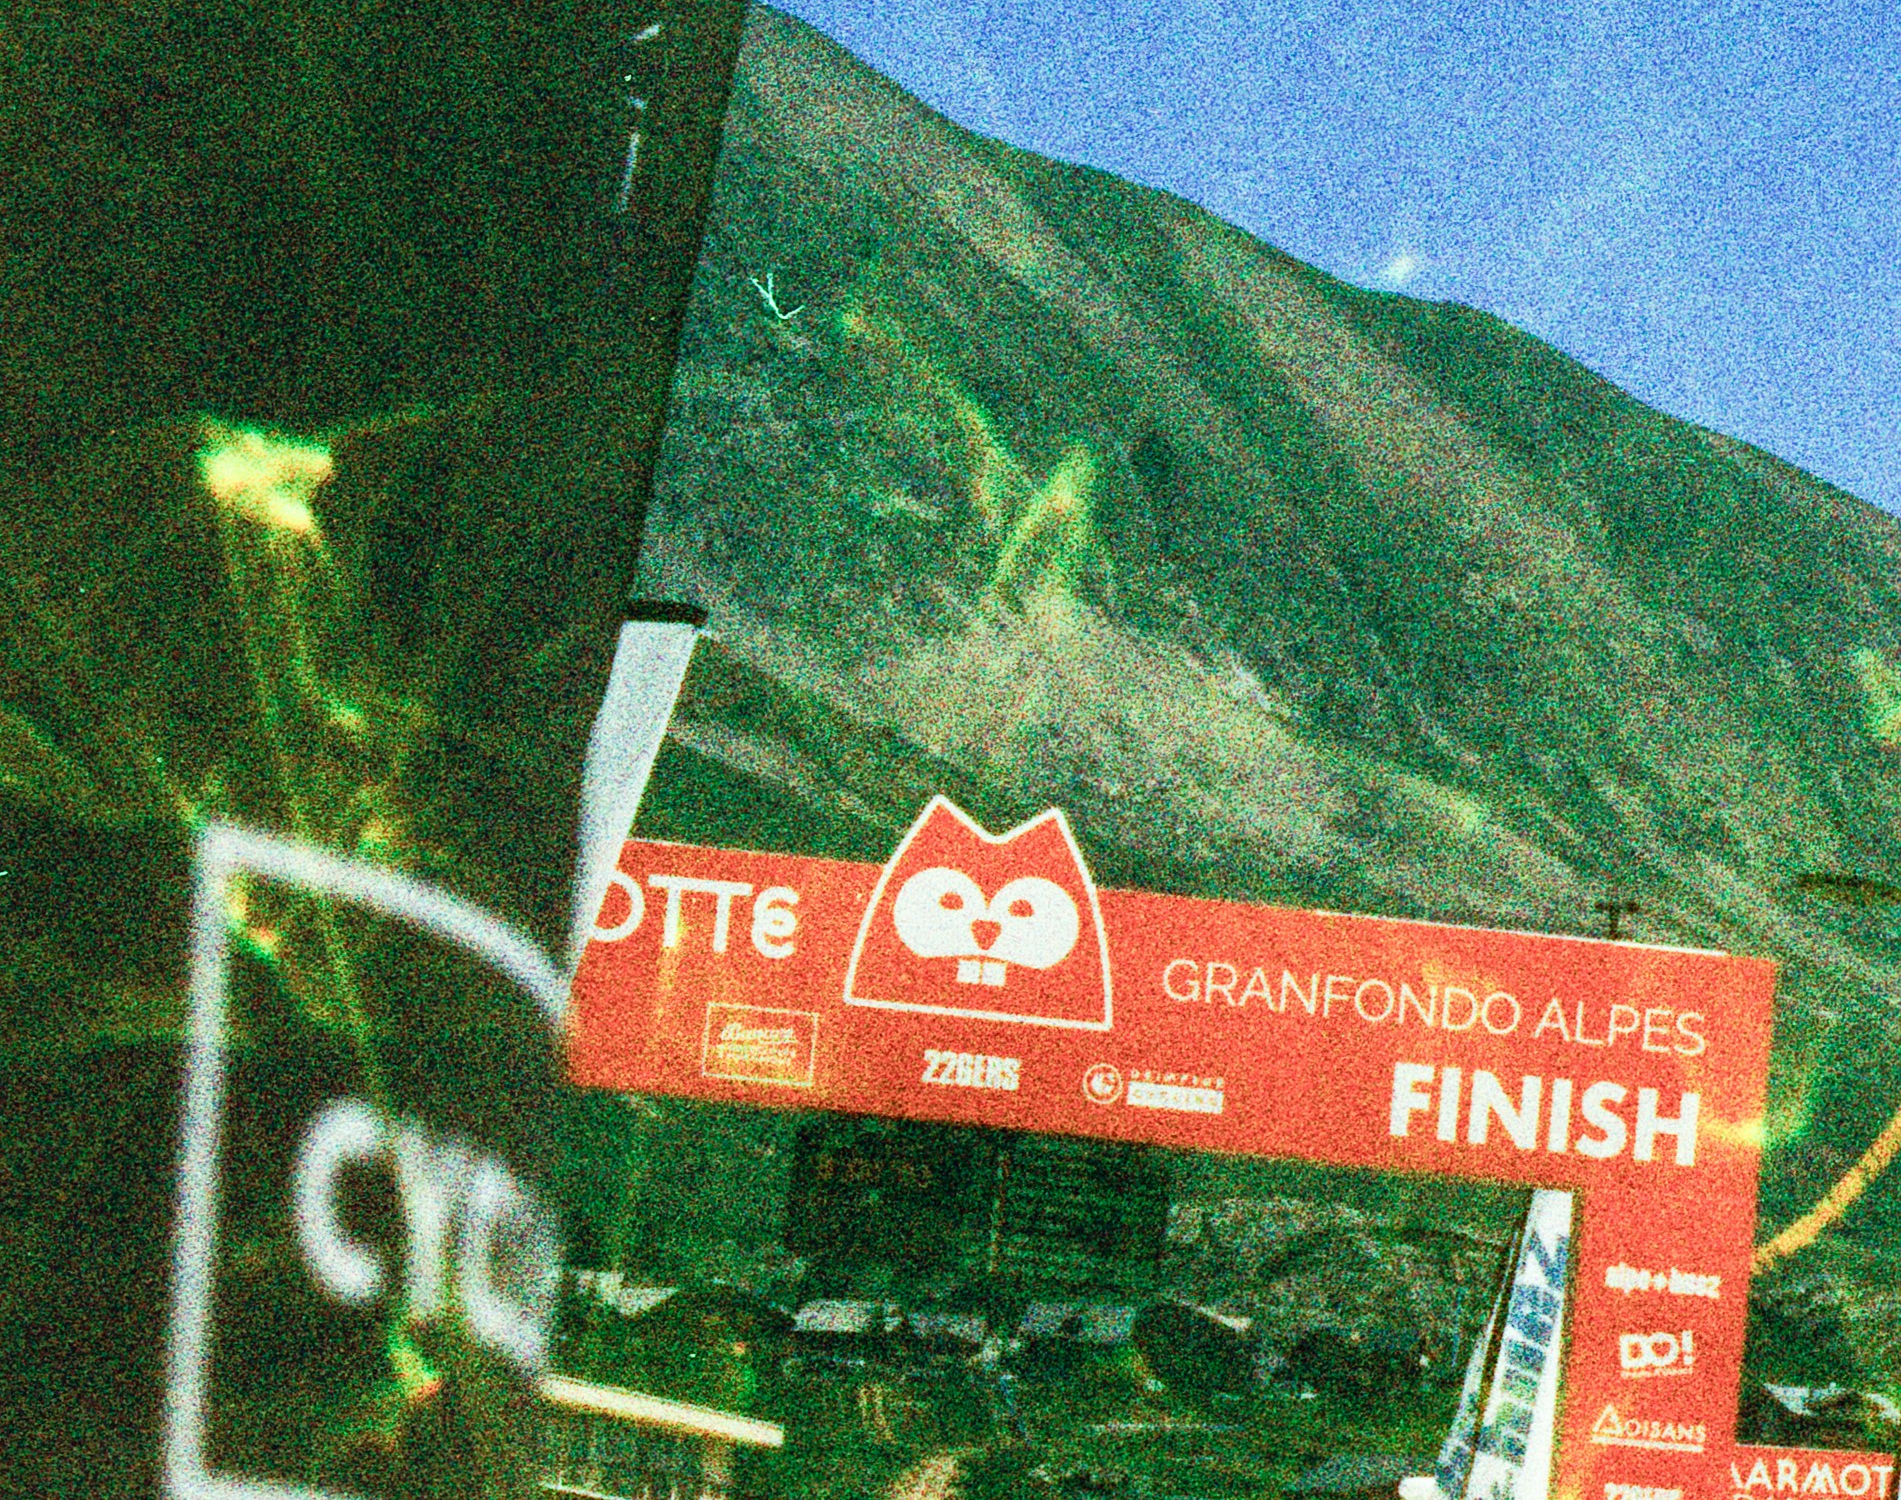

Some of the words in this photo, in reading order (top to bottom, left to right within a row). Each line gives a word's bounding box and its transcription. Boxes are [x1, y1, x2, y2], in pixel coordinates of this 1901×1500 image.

[1161, 959, 1521, 1037] GRANFONDO
[1533, 1001, 1708, 1056] ALPES
[1388, 1060, 1700, 1168] FINISH
